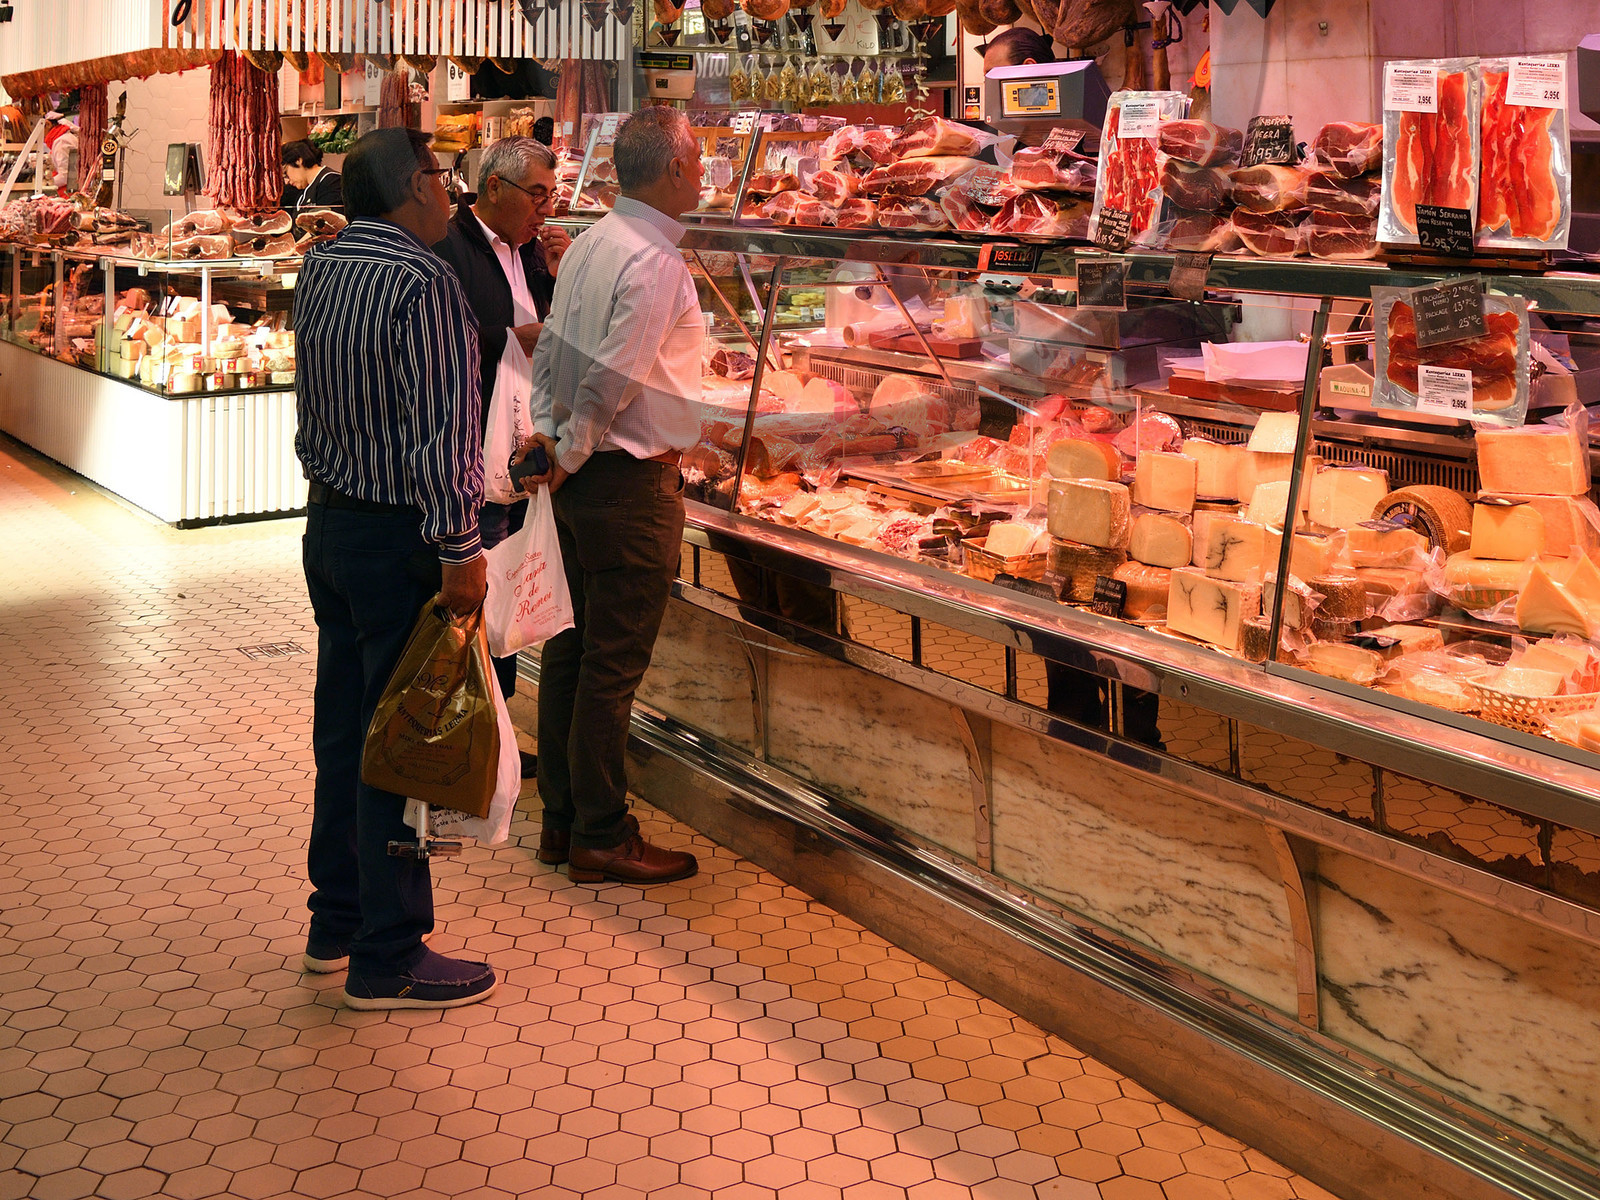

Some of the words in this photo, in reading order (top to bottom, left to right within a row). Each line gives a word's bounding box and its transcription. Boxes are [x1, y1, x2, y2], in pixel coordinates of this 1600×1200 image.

[1418, 95, 1432, 105] 2,95€
[1544, 90, 1560, 100] 2,95€
[1439, 208, 1468, 220] SERRANO
[1416, 311, 1422, 321] 5
[1452, 399, 1467, 409] 2,95€
[444, 708, 469, 732] LERMA
